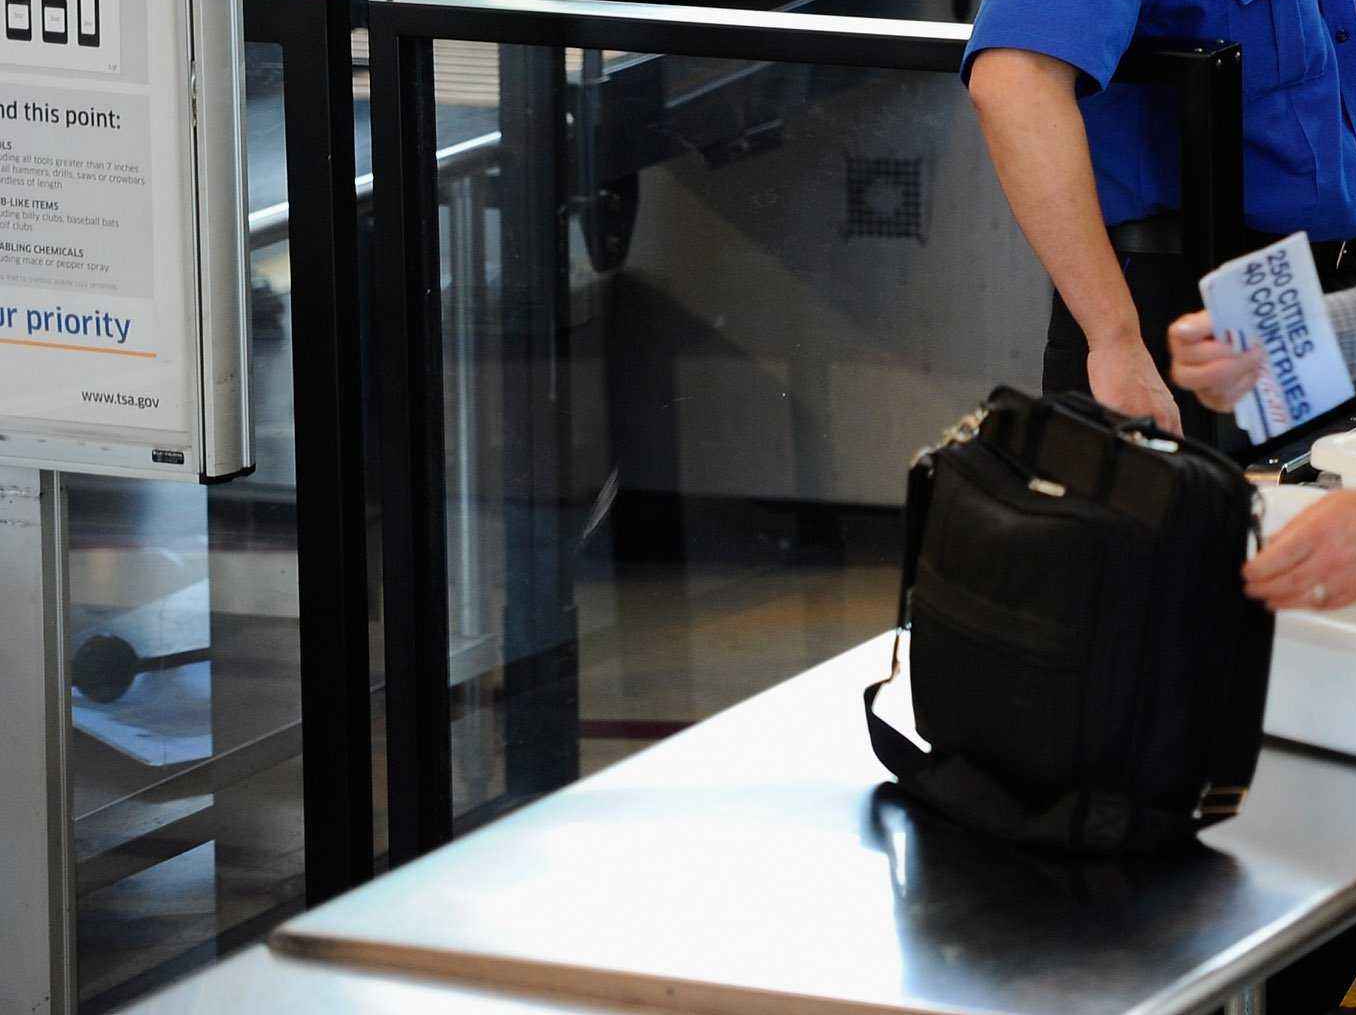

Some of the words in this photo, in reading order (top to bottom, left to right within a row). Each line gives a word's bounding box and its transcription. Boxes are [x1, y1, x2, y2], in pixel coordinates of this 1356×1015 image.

[24, 102, 60, 124] this
[65, 107, 121, 130] point:
[32, 200, 60, 211] ITEMS
[66, 215, 100, 226] baseball
[33, 244, 84, 258] CHEMICALS
[56, 259, 84, 270] pepper
[1243, 262, 1267, 285] 40
[1266, 249, 1292, 288] 250
[27, 306, 131, 344] priority
[1278, 289, 1315, 359] CITIES
[1251, 287, 1311, 422] COUNTRIES
[81, 390, 160, 410] www.tsa.gov
